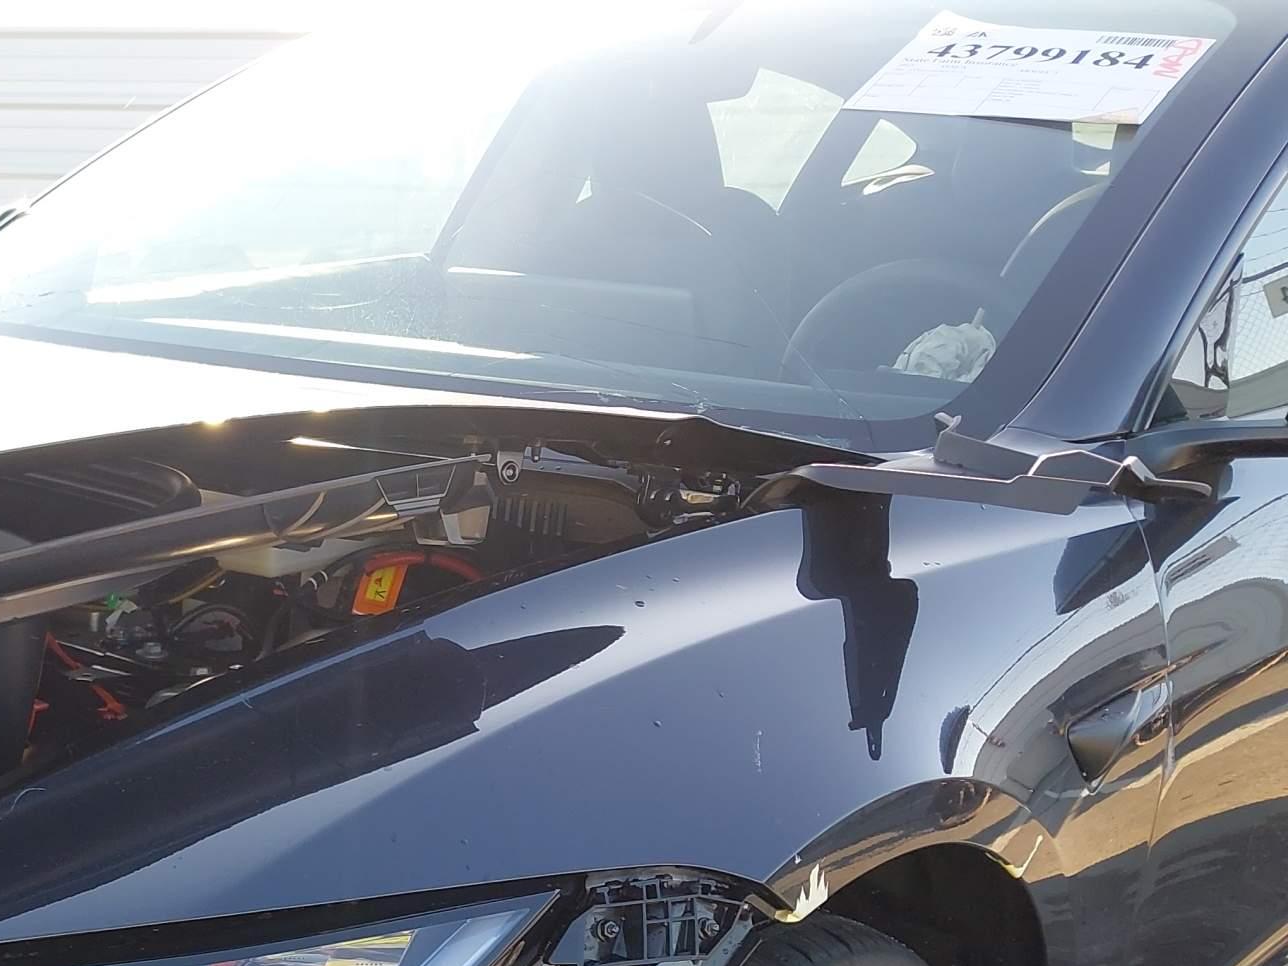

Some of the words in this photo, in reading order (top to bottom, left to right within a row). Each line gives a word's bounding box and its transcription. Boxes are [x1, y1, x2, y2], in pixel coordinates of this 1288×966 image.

[927, 42, 1154, 70] 43799184
[933, 57, 961, 65] Farm
[964, 59, 1018, 67] Insurance
